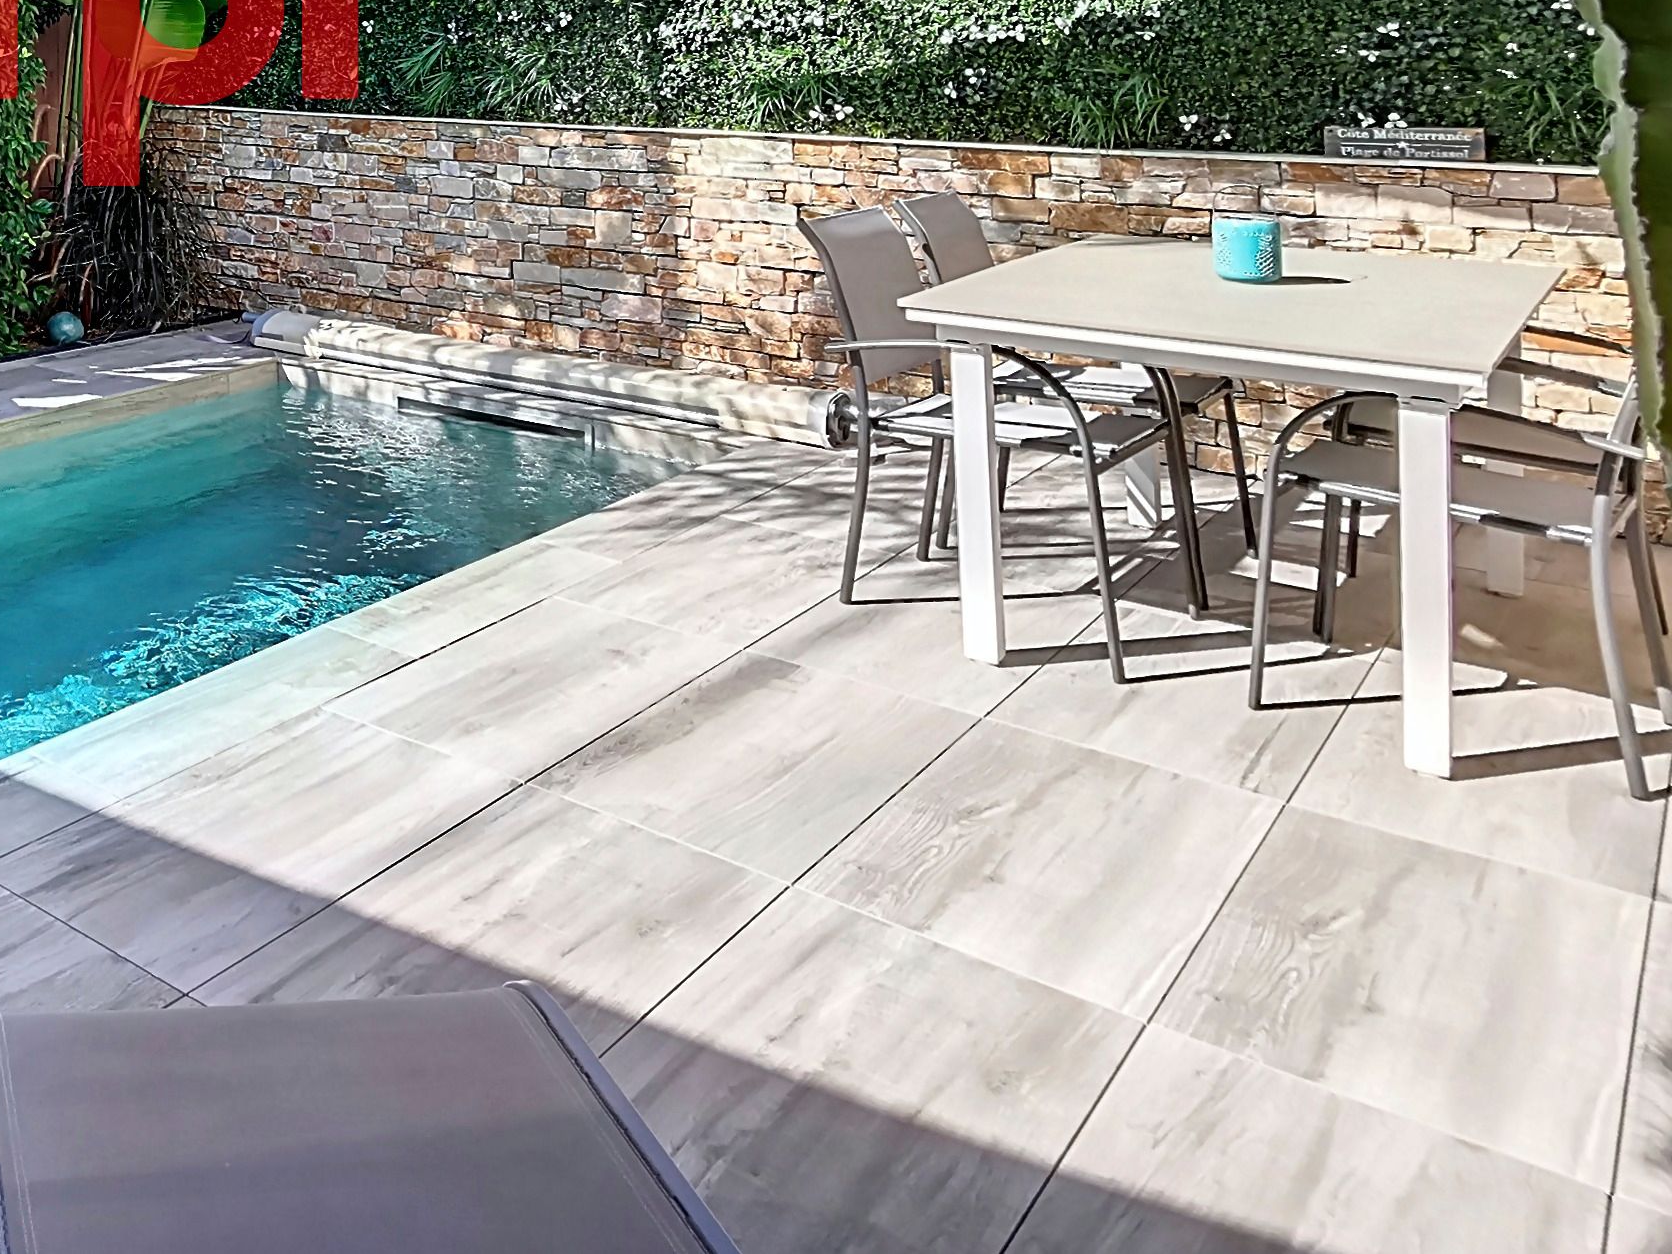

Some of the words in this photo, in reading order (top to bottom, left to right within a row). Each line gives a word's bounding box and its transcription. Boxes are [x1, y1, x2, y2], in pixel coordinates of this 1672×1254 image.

[1373, 128, 1473, 142] Méditerranée
[1341, 146, 1379, 158] Plage
[1383, 147, 1401, 157] de
[1404, 147, 1469, 159] Portissol
